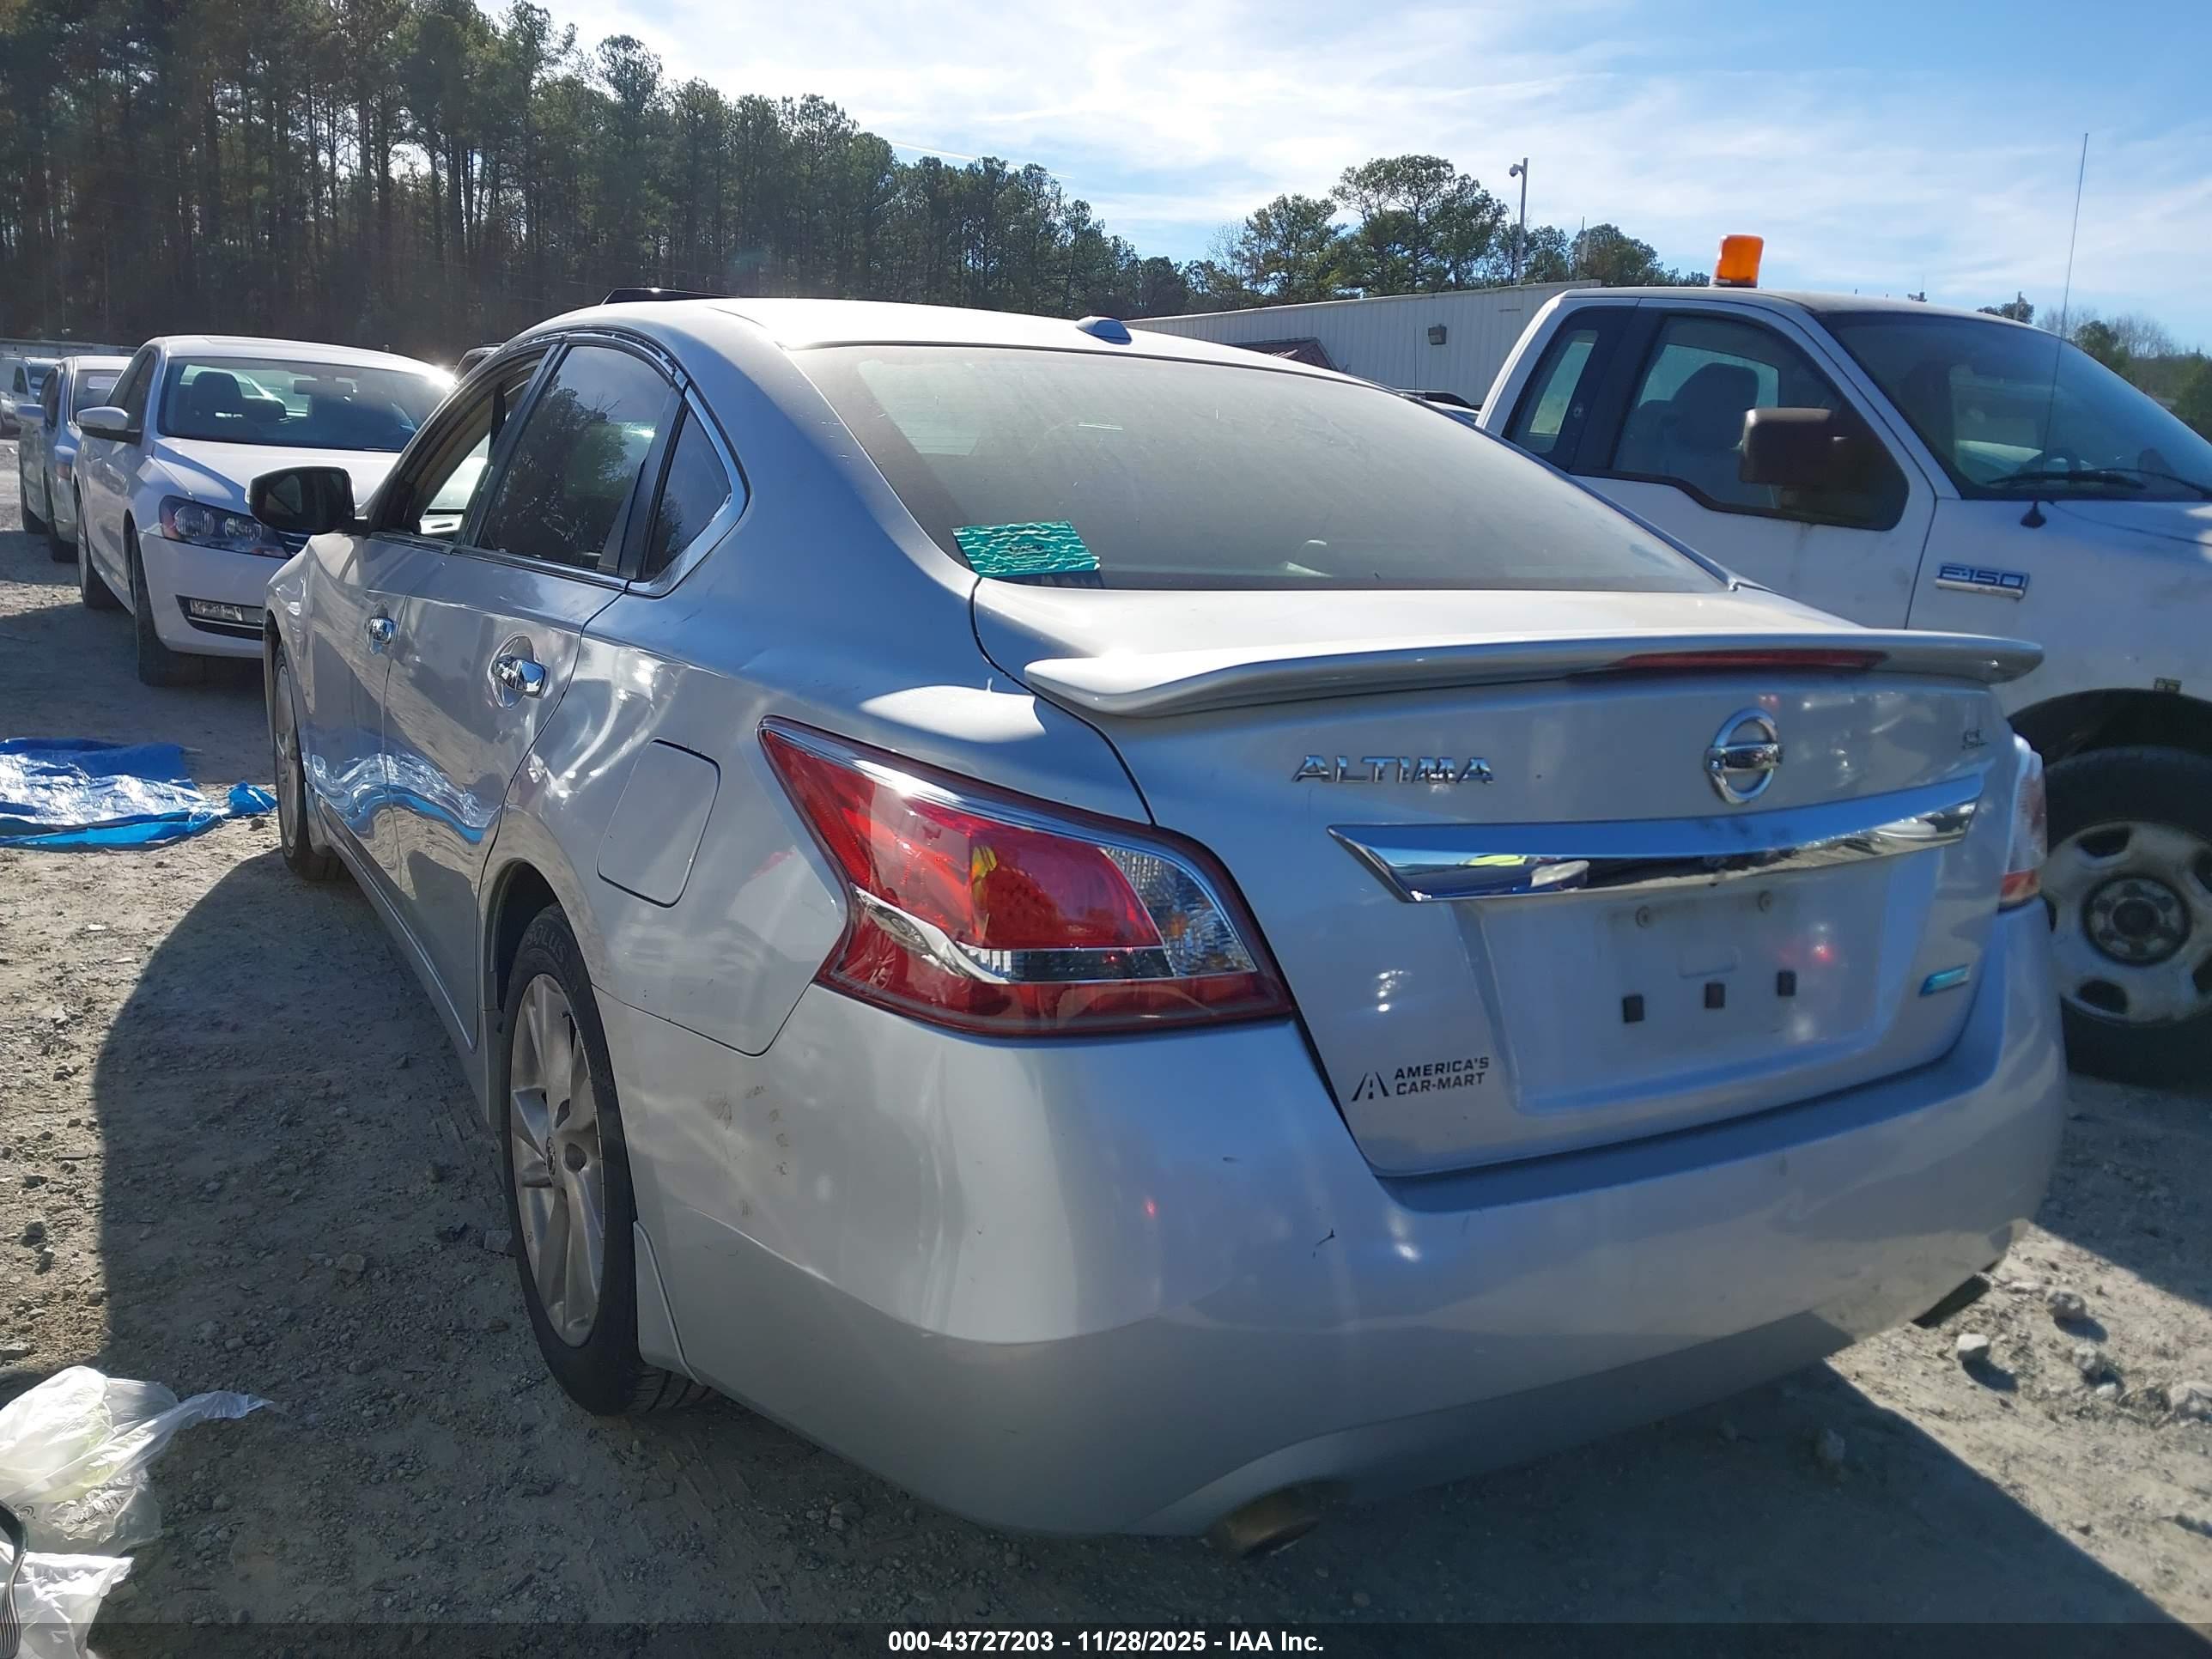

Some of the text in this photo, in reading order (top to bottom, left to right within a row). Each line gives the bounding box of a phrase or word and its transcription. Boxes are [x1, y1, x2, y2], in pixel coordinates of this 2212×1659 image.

[1937, 564, 2027, 591] F-150
[1291, 754, 1494, 784] ALTIMA
[1394, 1056, 1490, 1080] AMERICA'S
[1395, 1073, 1486, 1096] CAR-MART
